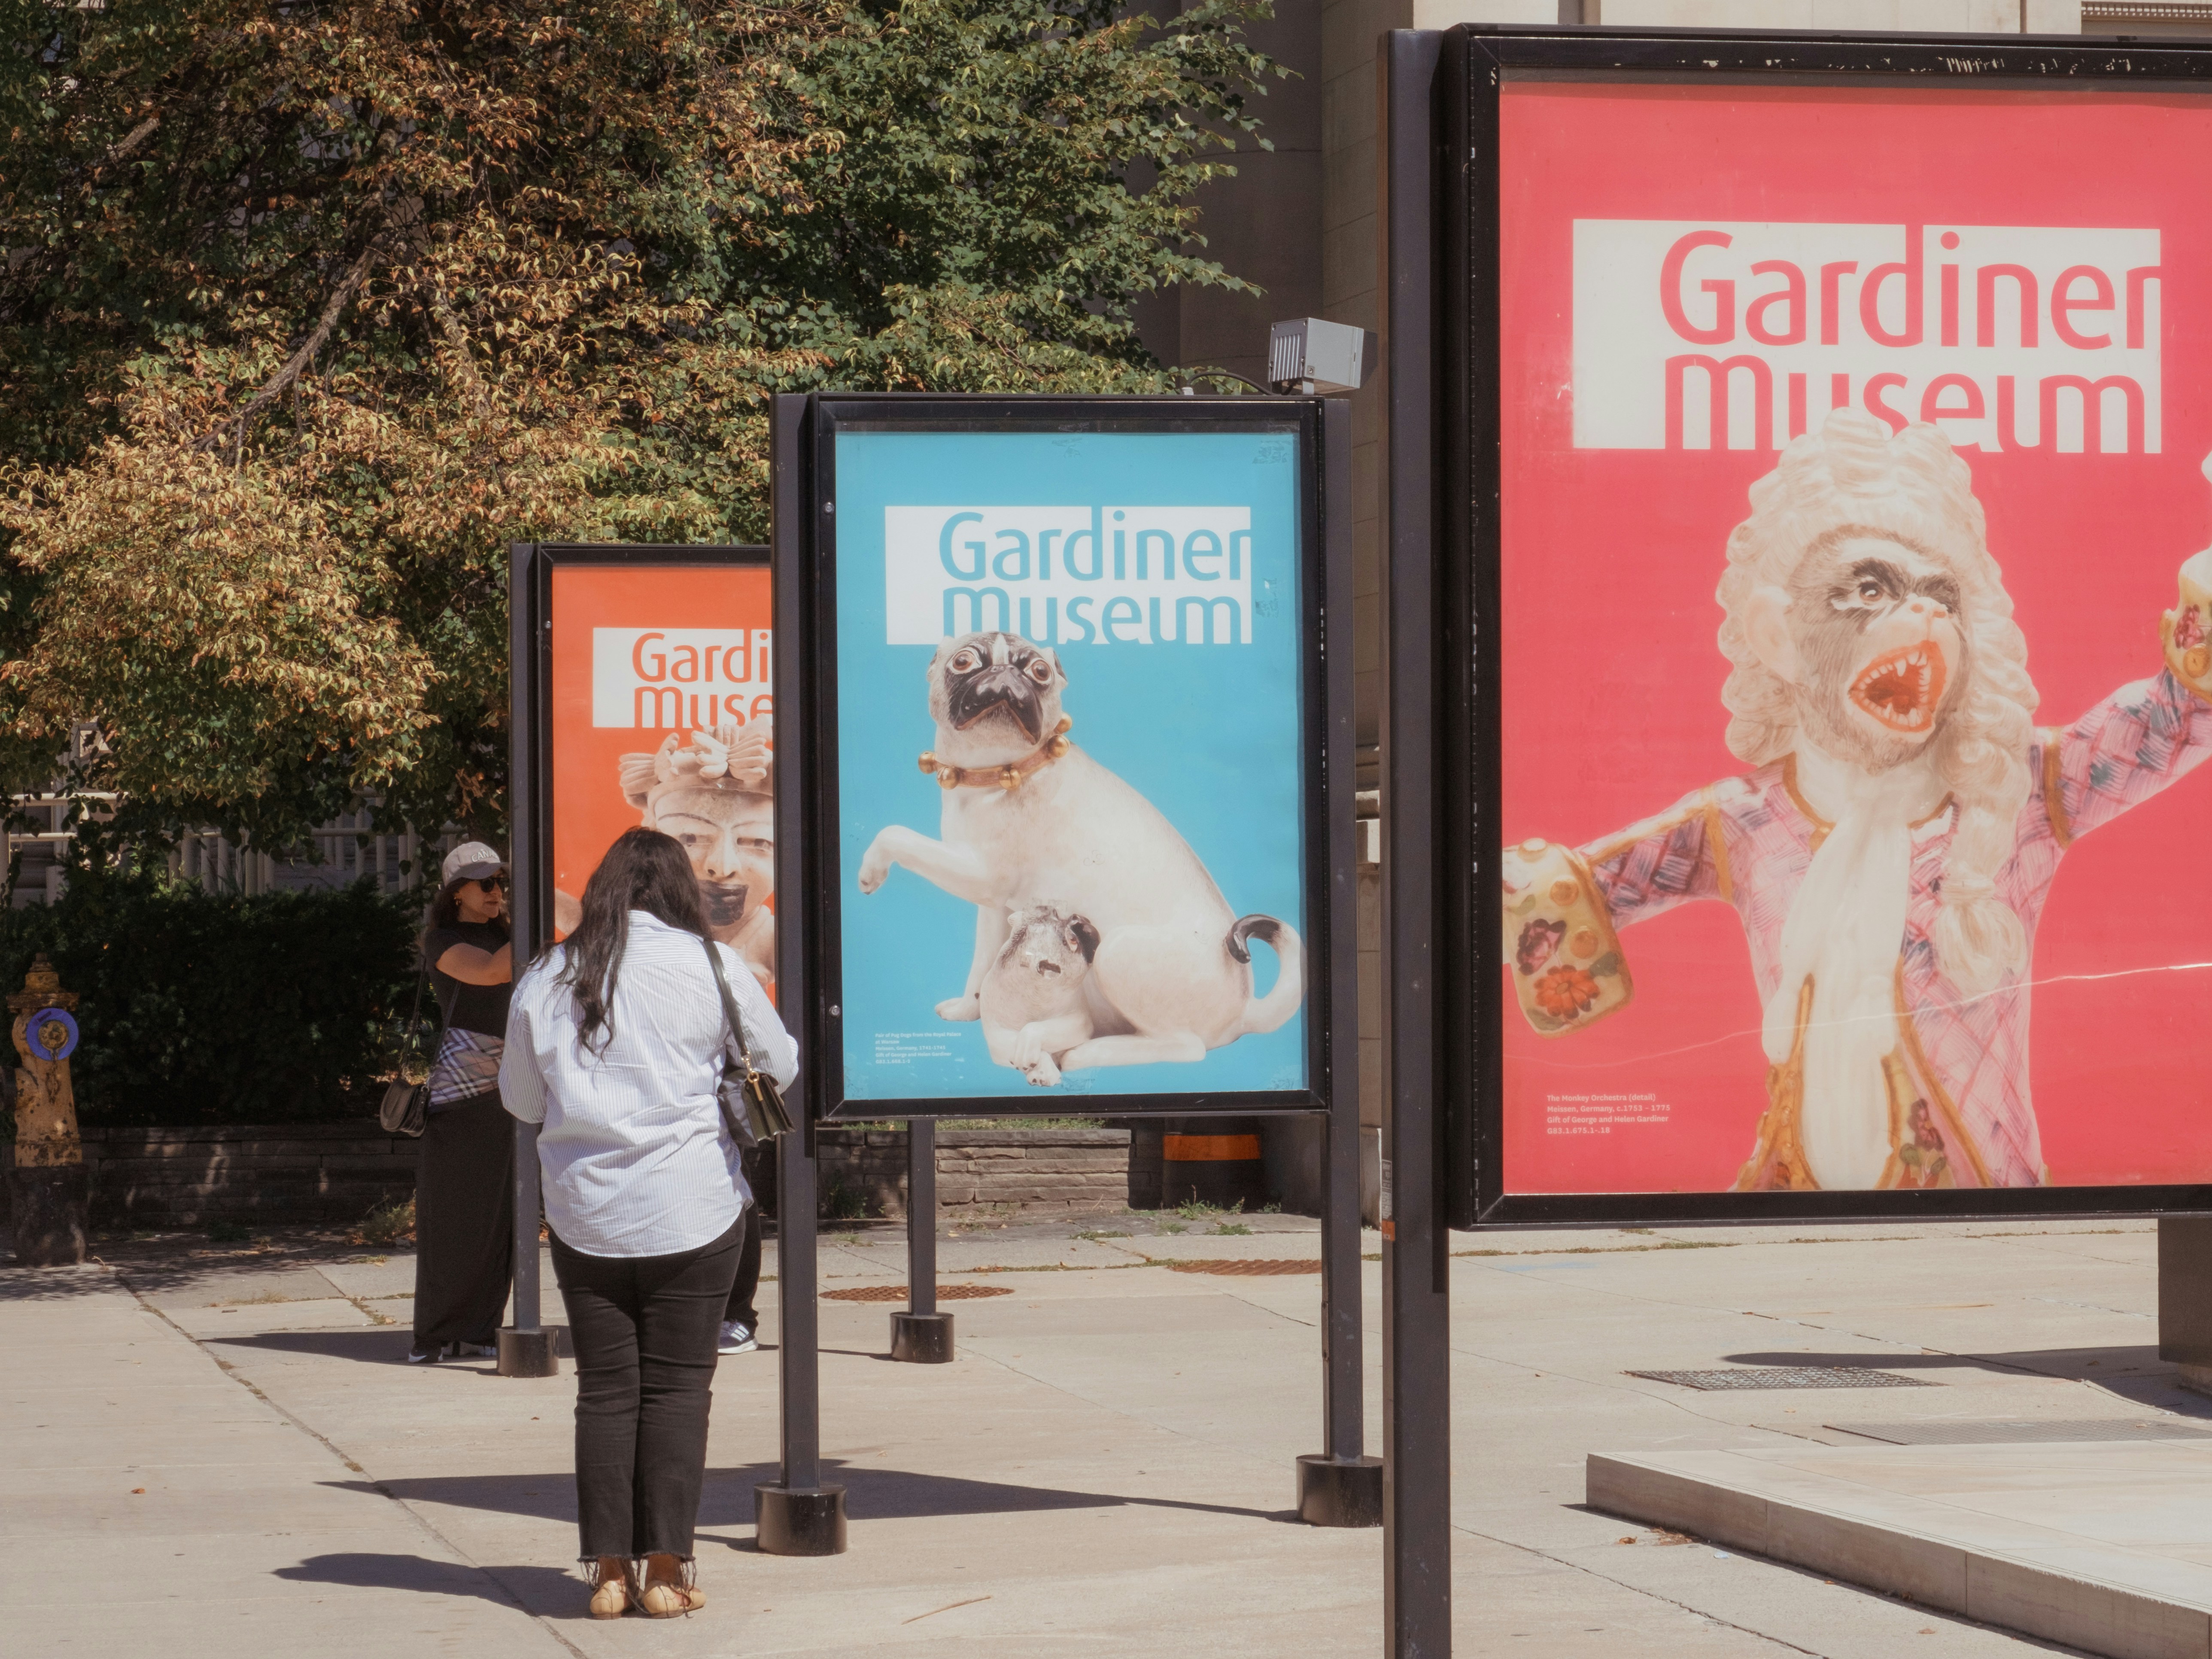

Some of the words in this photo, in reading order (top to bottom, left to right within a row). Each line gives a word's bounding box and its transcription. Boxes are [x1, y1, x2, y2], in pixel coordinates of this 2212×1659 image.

[1660, 225, 2160, 349] Gardiner
[939, 507, 1250, 581] Gardiner
[632, 629, 768, 683] Gardi
[1562, 1094, 1589, 1103] Monkey
[1629, 1093, 1655, 1102] (detail)
[1580, 1105, 1614, 1113] Germany,
[1571, 1116, 1597, 1125] George
